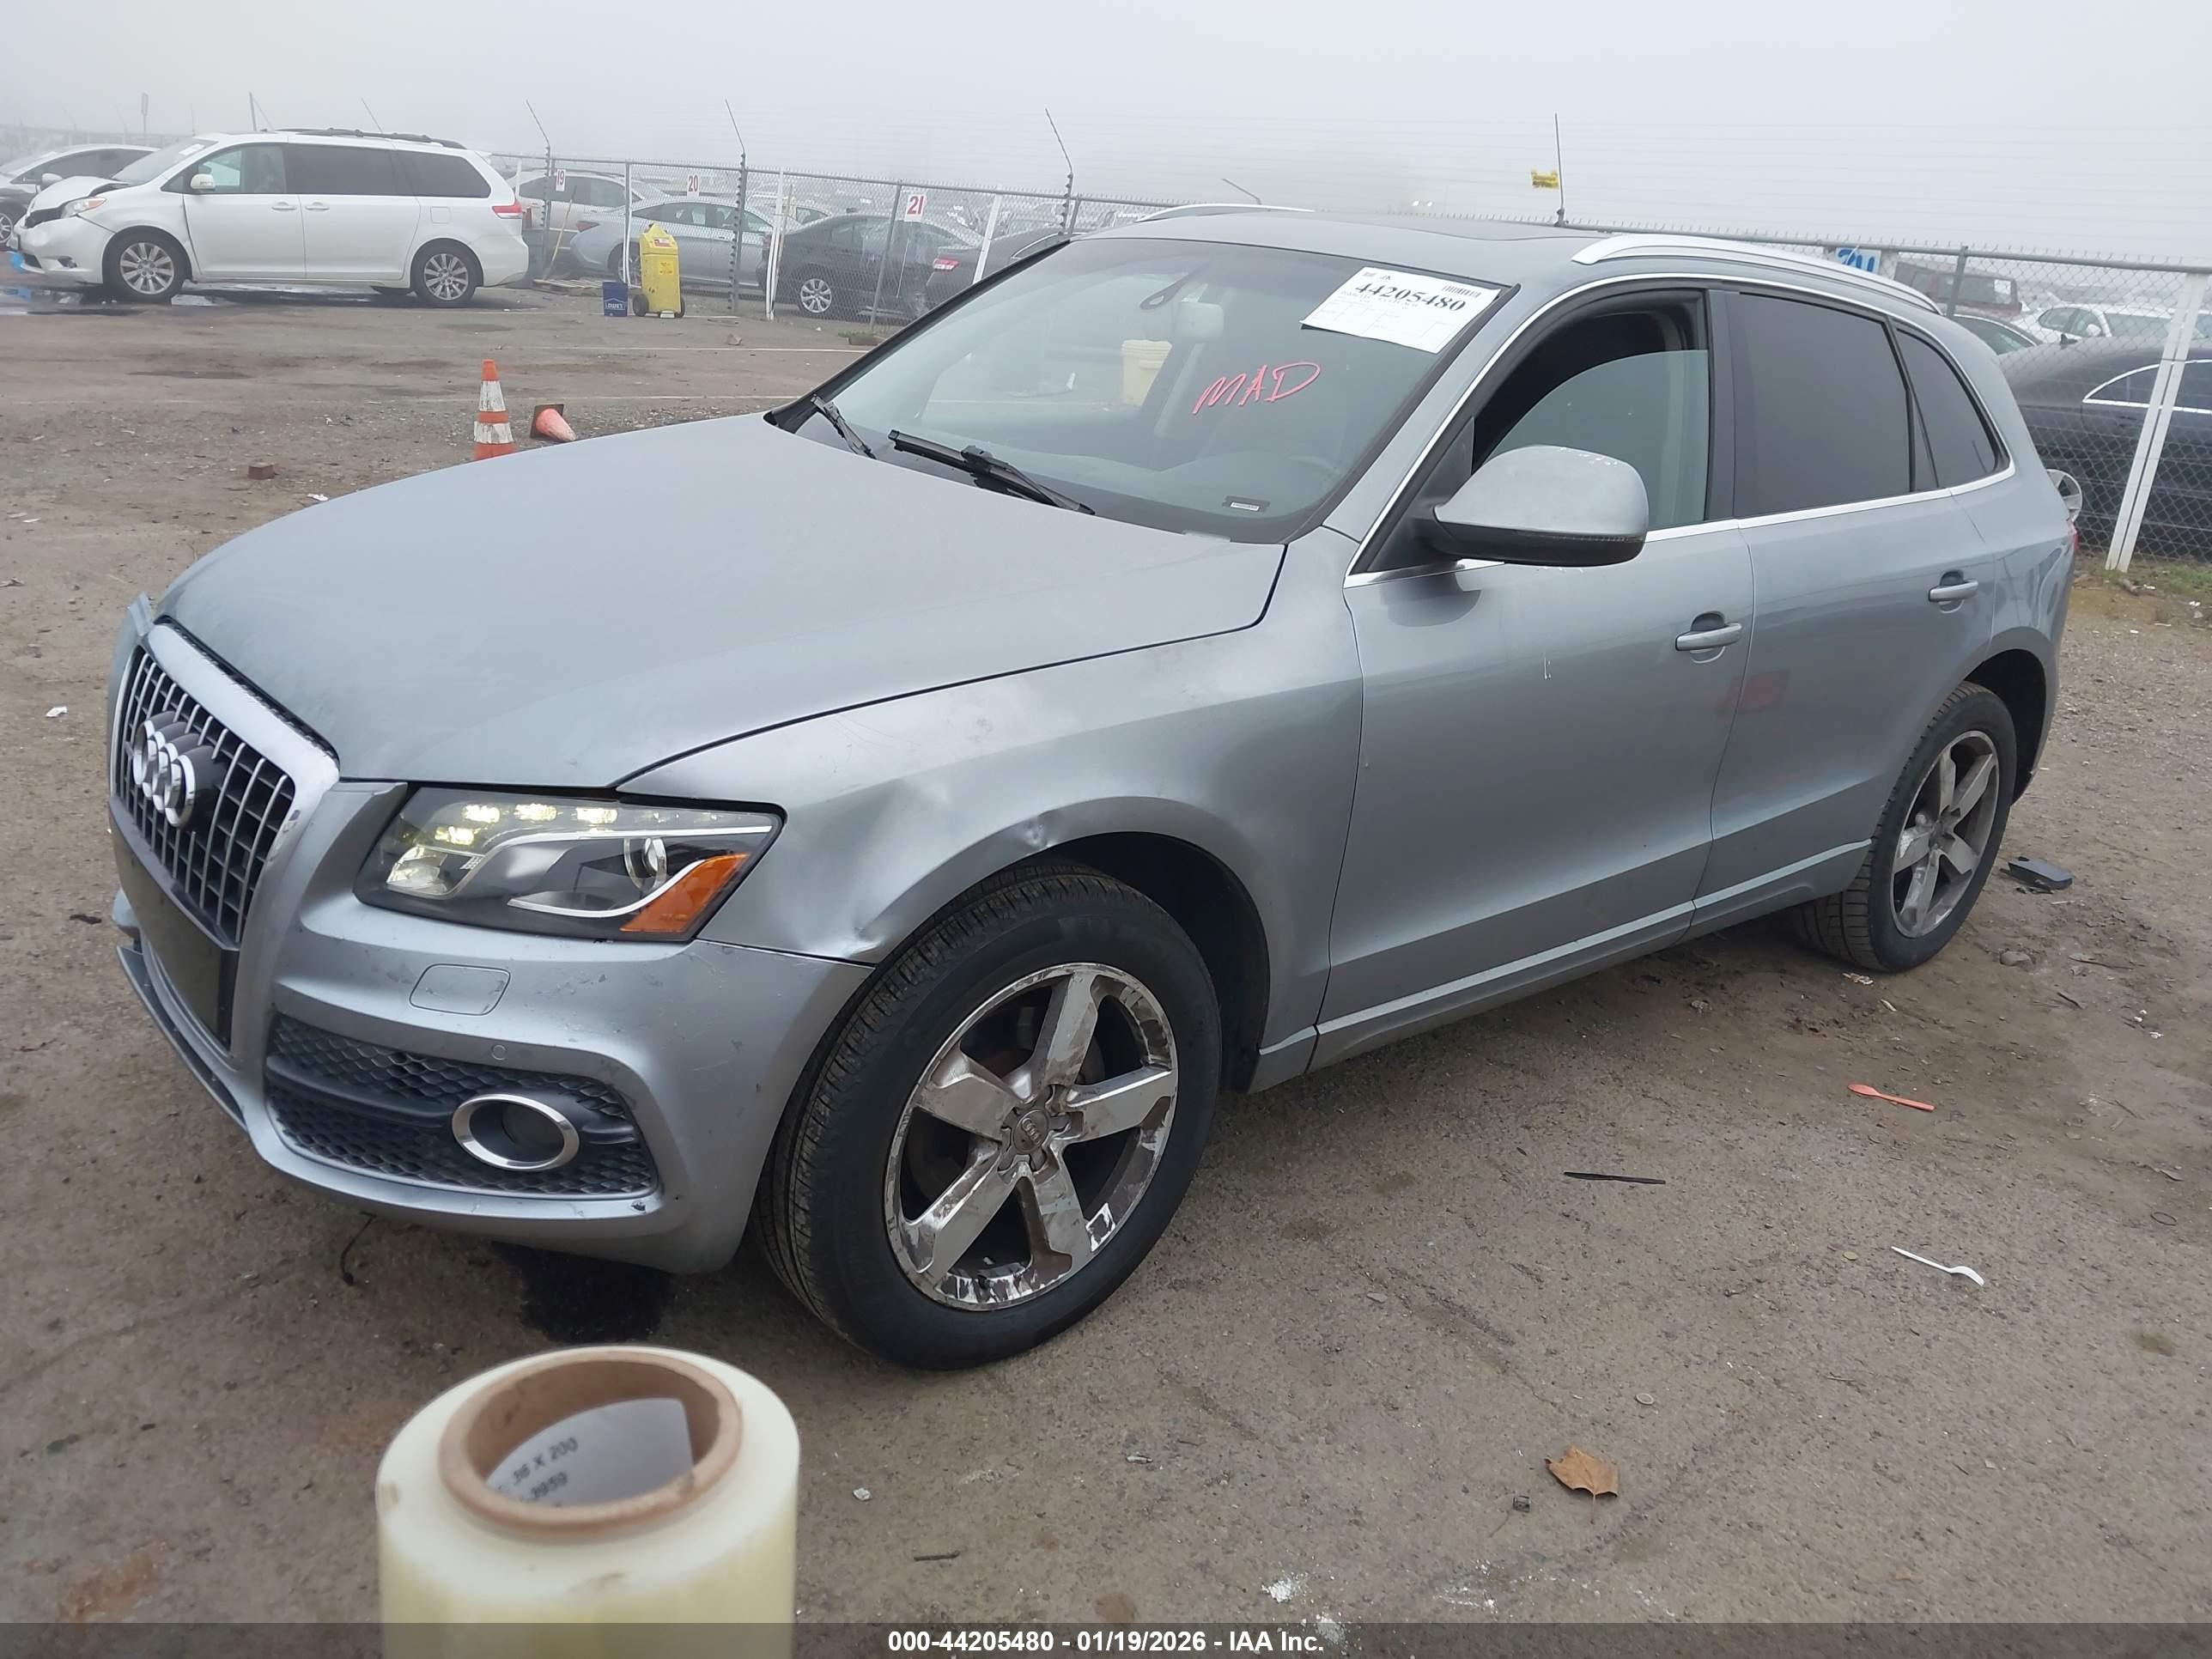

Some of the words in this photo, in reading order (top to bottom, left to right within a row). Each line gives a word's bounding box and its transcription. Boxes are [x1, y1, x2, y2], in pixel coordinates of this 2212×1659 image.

[557, 170, 565, 185] 19
[688, 174, 699, 192] 20
[907, 196, 925, 215] 21
[1354, 283, 1467, 311] 44205480
[1192, 362, 1322, 416] MAD
[550, 1437, 579, 1461] 200
